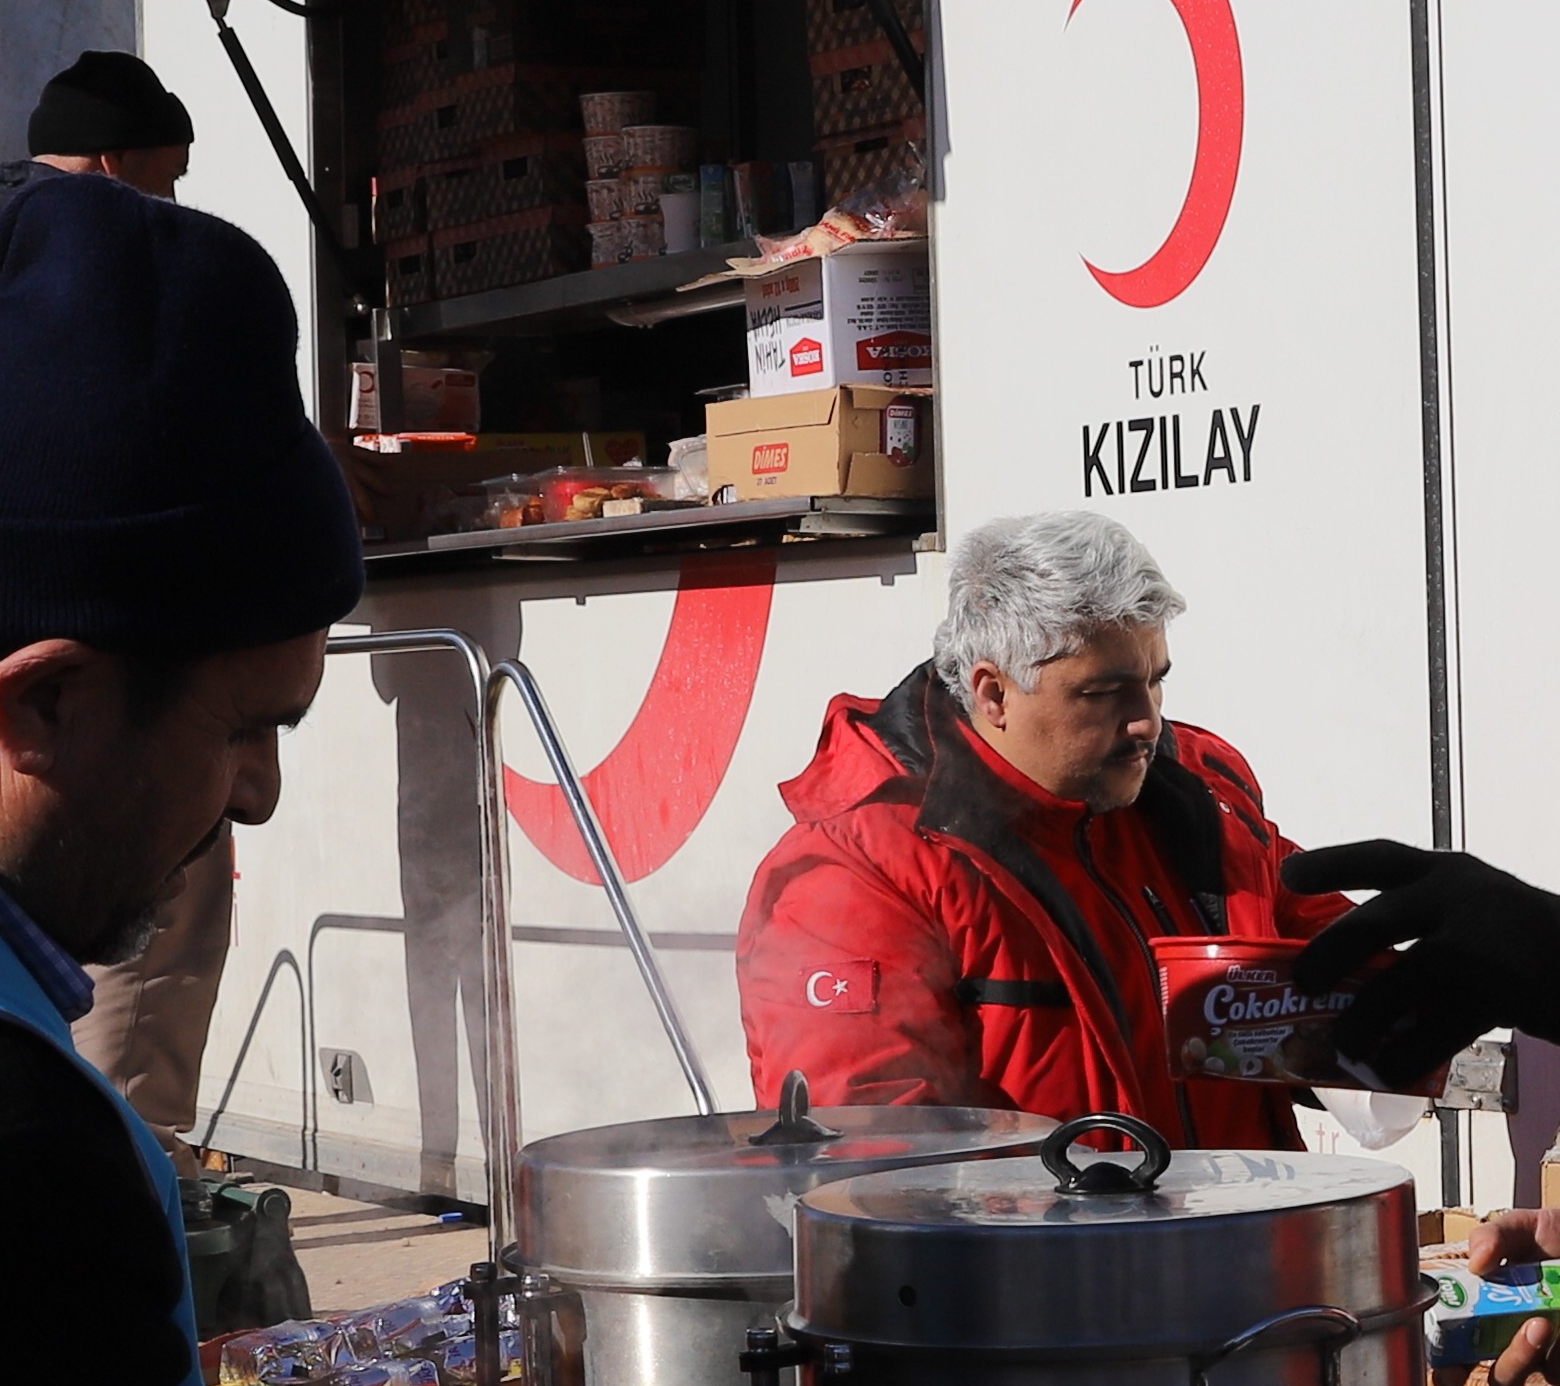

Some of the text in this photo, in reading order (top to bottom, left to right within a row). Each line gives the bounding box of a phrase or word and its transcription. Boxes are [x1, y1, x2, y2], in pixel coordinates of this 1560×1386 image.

[1129, 345, 1208, 399] TÜRK
[754, 445, 788, 470] DİMES
[1082, 404, 1261, 498] KIZILAY
[1227, 965, 1277, 984] ÜLKER
